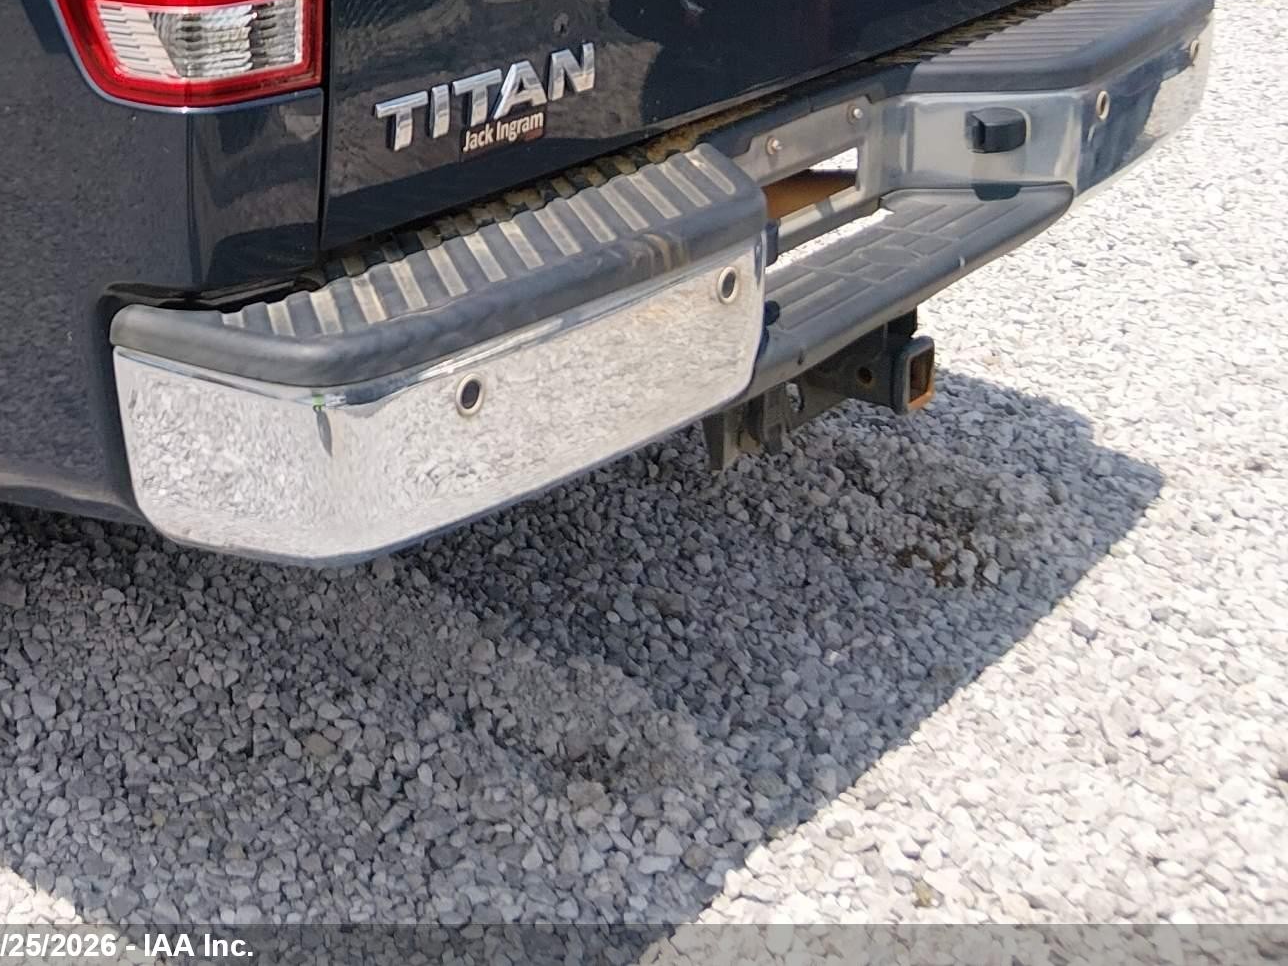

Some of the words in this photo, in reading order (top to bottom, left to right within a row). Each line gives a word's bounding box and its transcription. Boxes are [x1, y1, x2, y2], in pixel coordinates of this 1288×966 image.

[374, 41, 596, 152] TITAN
[462, 121, 494, 154] Jack
[496, 111, 544, 143] Ingram
